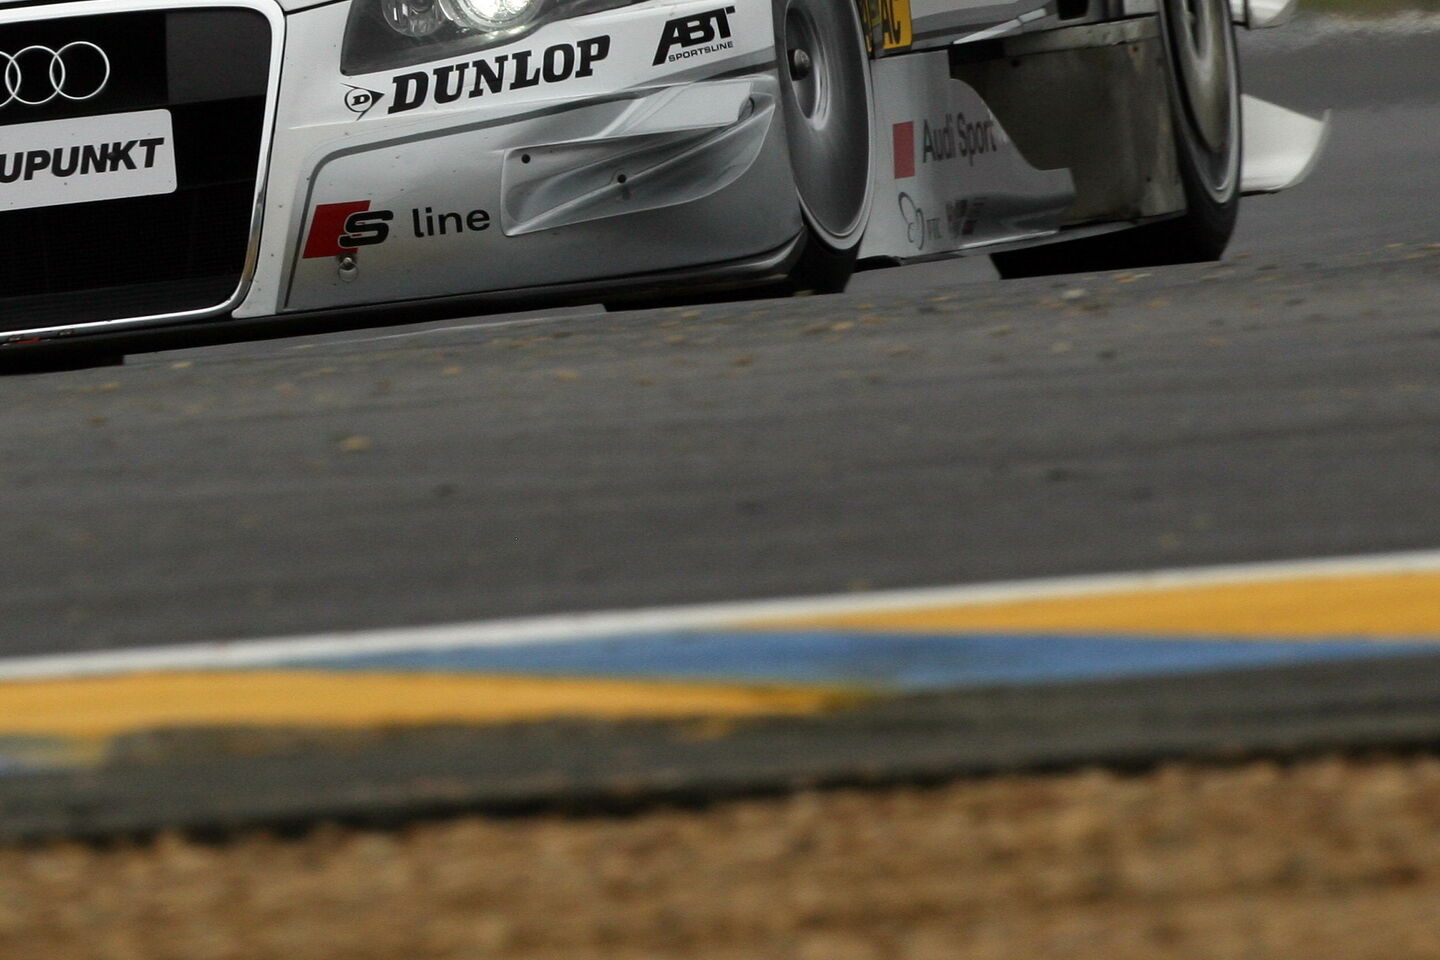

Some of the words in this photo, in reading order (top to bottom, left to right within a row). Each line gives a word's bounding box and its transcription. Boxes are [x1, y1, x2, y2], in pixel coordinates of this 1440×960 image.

[652, 6, 736, 66] ABT
[668, 41, 734, 62] SPORTSLINE
[387, 35, 611, 115] DUNLOP
[922, 113, 956, 163] Audi
[957, 112, 997, 167] Sport
[338, 210, 395, 248] S
[412, 207, 491, 238] line
